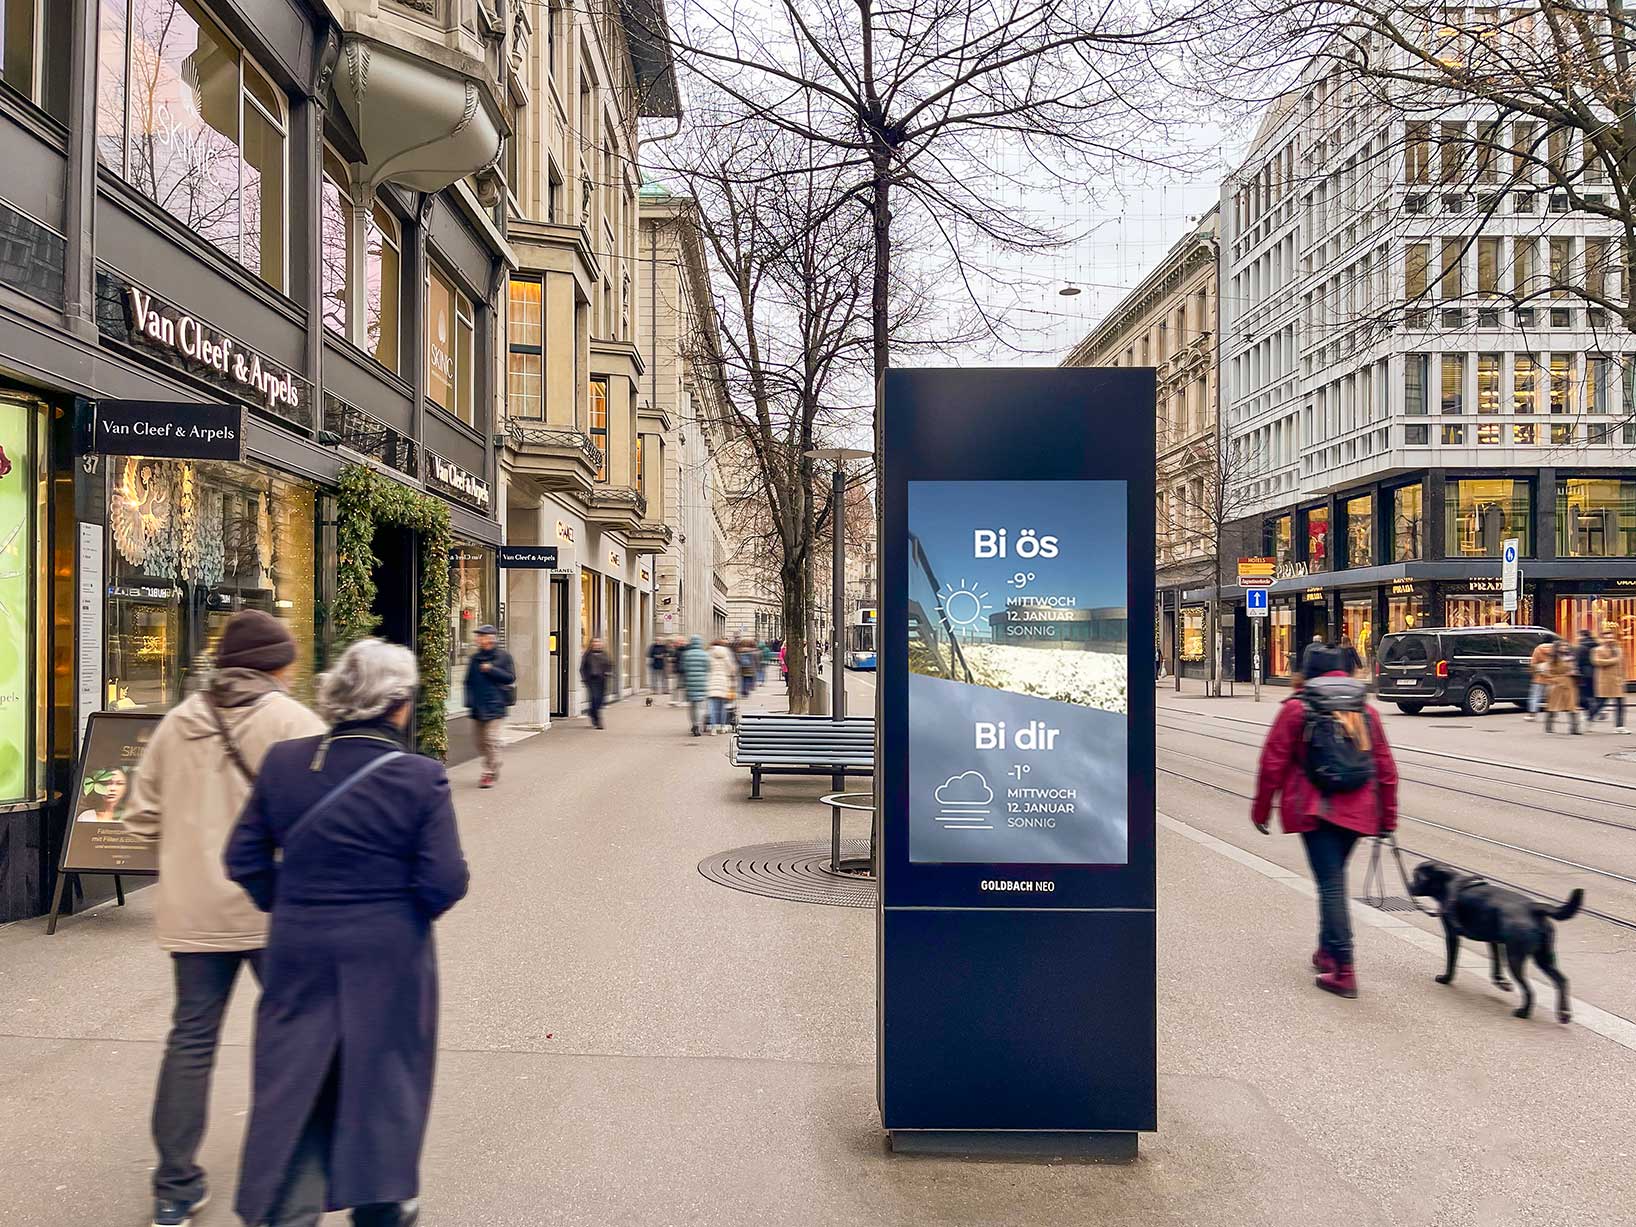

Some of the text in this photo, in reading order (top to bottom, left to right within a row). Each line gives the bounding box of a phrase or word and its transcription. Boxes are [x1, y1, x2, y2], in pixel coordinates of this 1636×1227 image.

[130, 286, 299, 407] Van Cleef & Arpels
[102, 420, 235, 442] Van Cleef & Arpels
[82, 454, 98, 475] 37
[434, 455, 448, 484] Van
[974, 528, 1059, 559] Bi ös
[502, 553, 515, 561] Van
[515, 553, 532, 561] Cleef
[537, 554, 556, 563] Arpels
[1276, 560, 1309, 579] PRADA
[1006, 596, 1076, 607] MITTWOCH
[1006, 611, 1074, 622] 12. JANUAR
[1006, 625, 1056, 636] SONNIG
[975, 720, 1060, 750] Bi dir
[1007, 788, 1077, 800] MITTWOCH
[1007, 803, 1075, 814] 12. JANUAR
[1007, 817, 1056, 829] SONNIG
[981, 880, 1055, 892] GOLDBACH NEO
